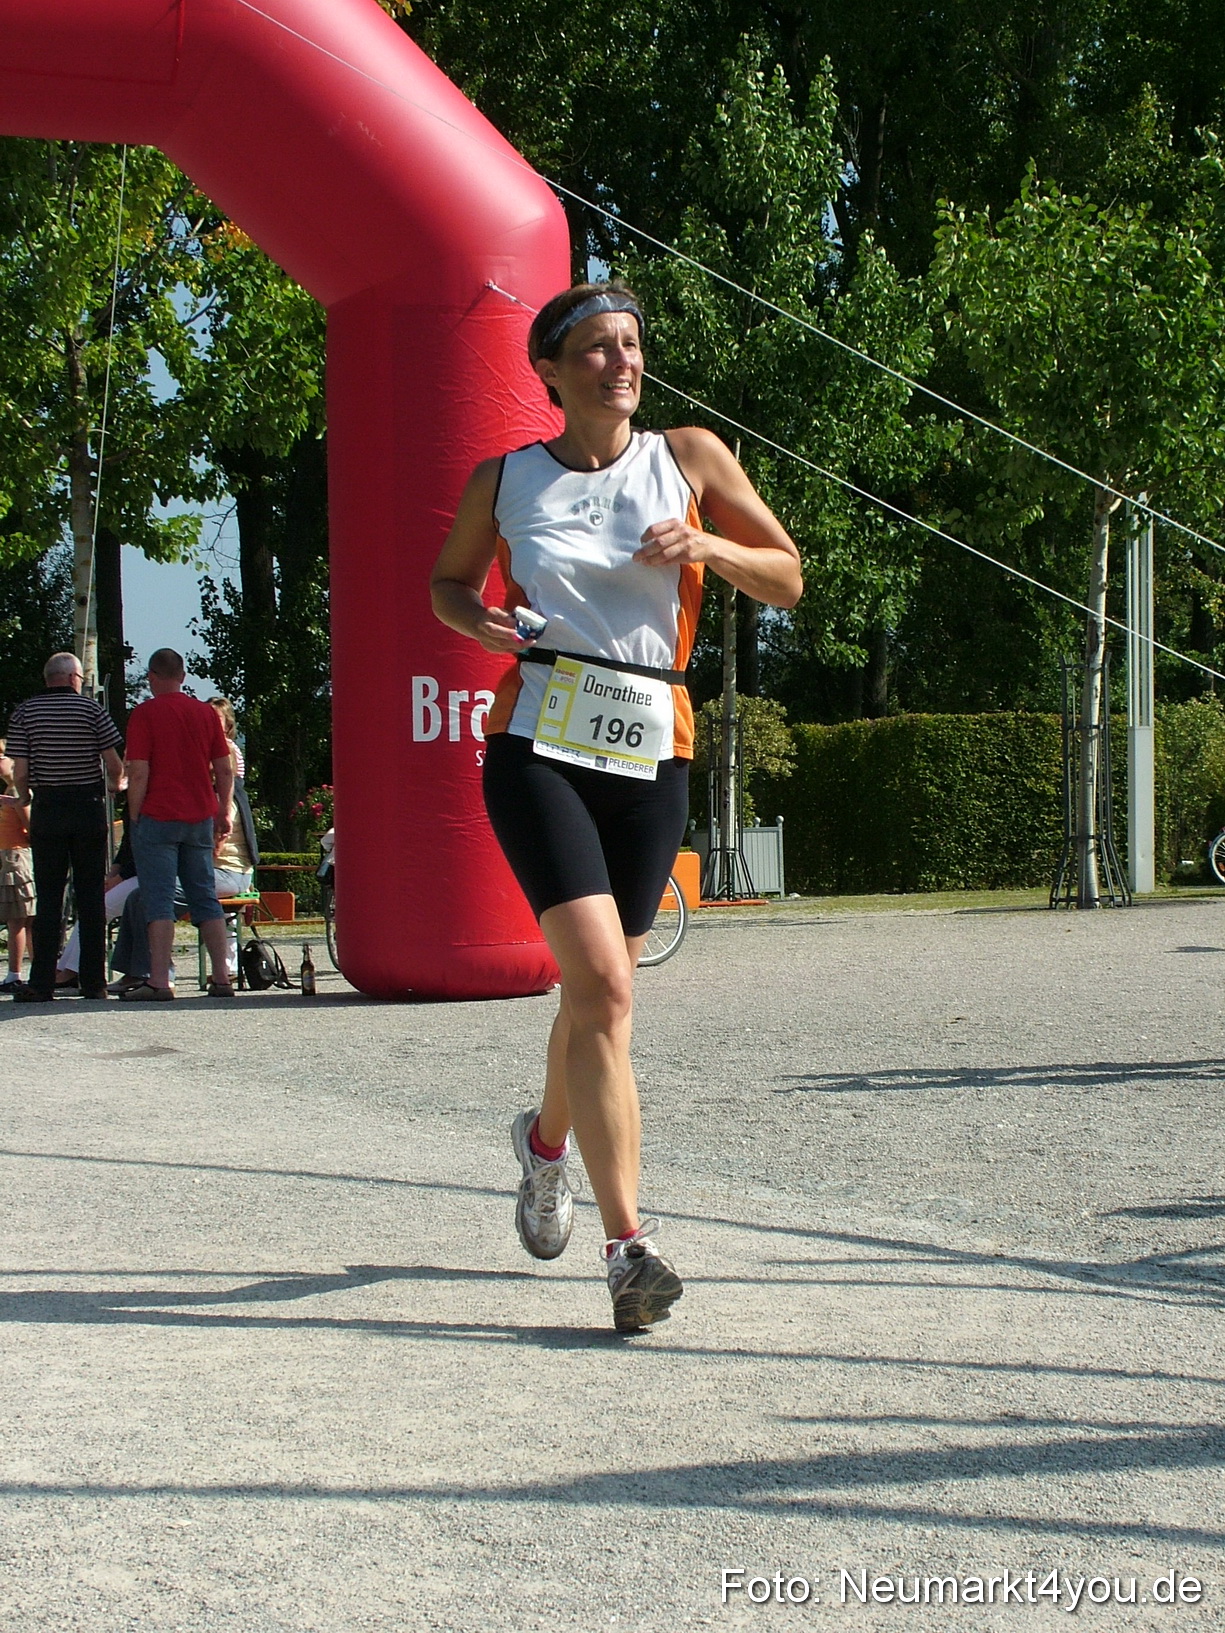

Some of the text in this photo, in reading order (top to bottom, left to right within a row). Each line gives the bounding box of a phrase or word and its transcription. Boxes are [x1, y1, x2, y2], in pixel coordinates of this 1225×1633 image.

[548, 695, 558, 709] D
[583, 673, 652, 706] Dorothee
[589, 714, 645, 748] 196
[608, 757, 655, 775] PFLEIDERER
